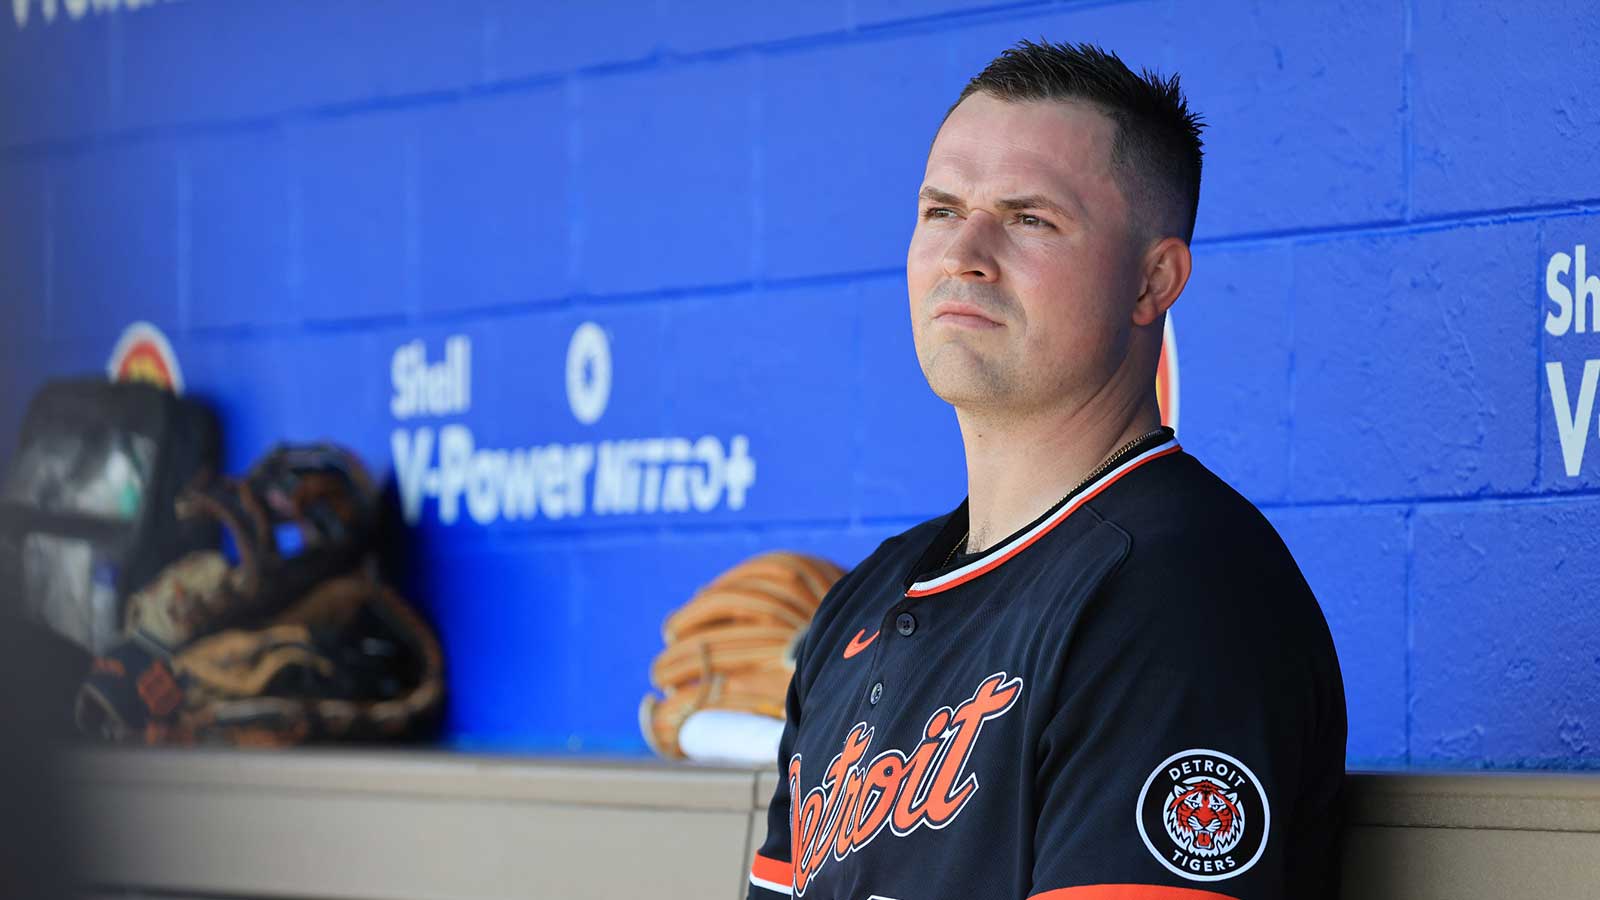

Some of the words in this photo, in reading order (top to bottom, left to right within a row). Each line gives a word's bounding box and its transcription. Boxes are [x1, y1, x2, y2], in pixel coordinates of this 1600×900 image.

[1544, 245, 1600, 336] Sh
[391, 334, 472, 420] Shell
[391, 424, 593, 525] V-Power
[1168, 759, 1246, 788] DETROIT
[1171, 849, 1236, 872] TIGERS
